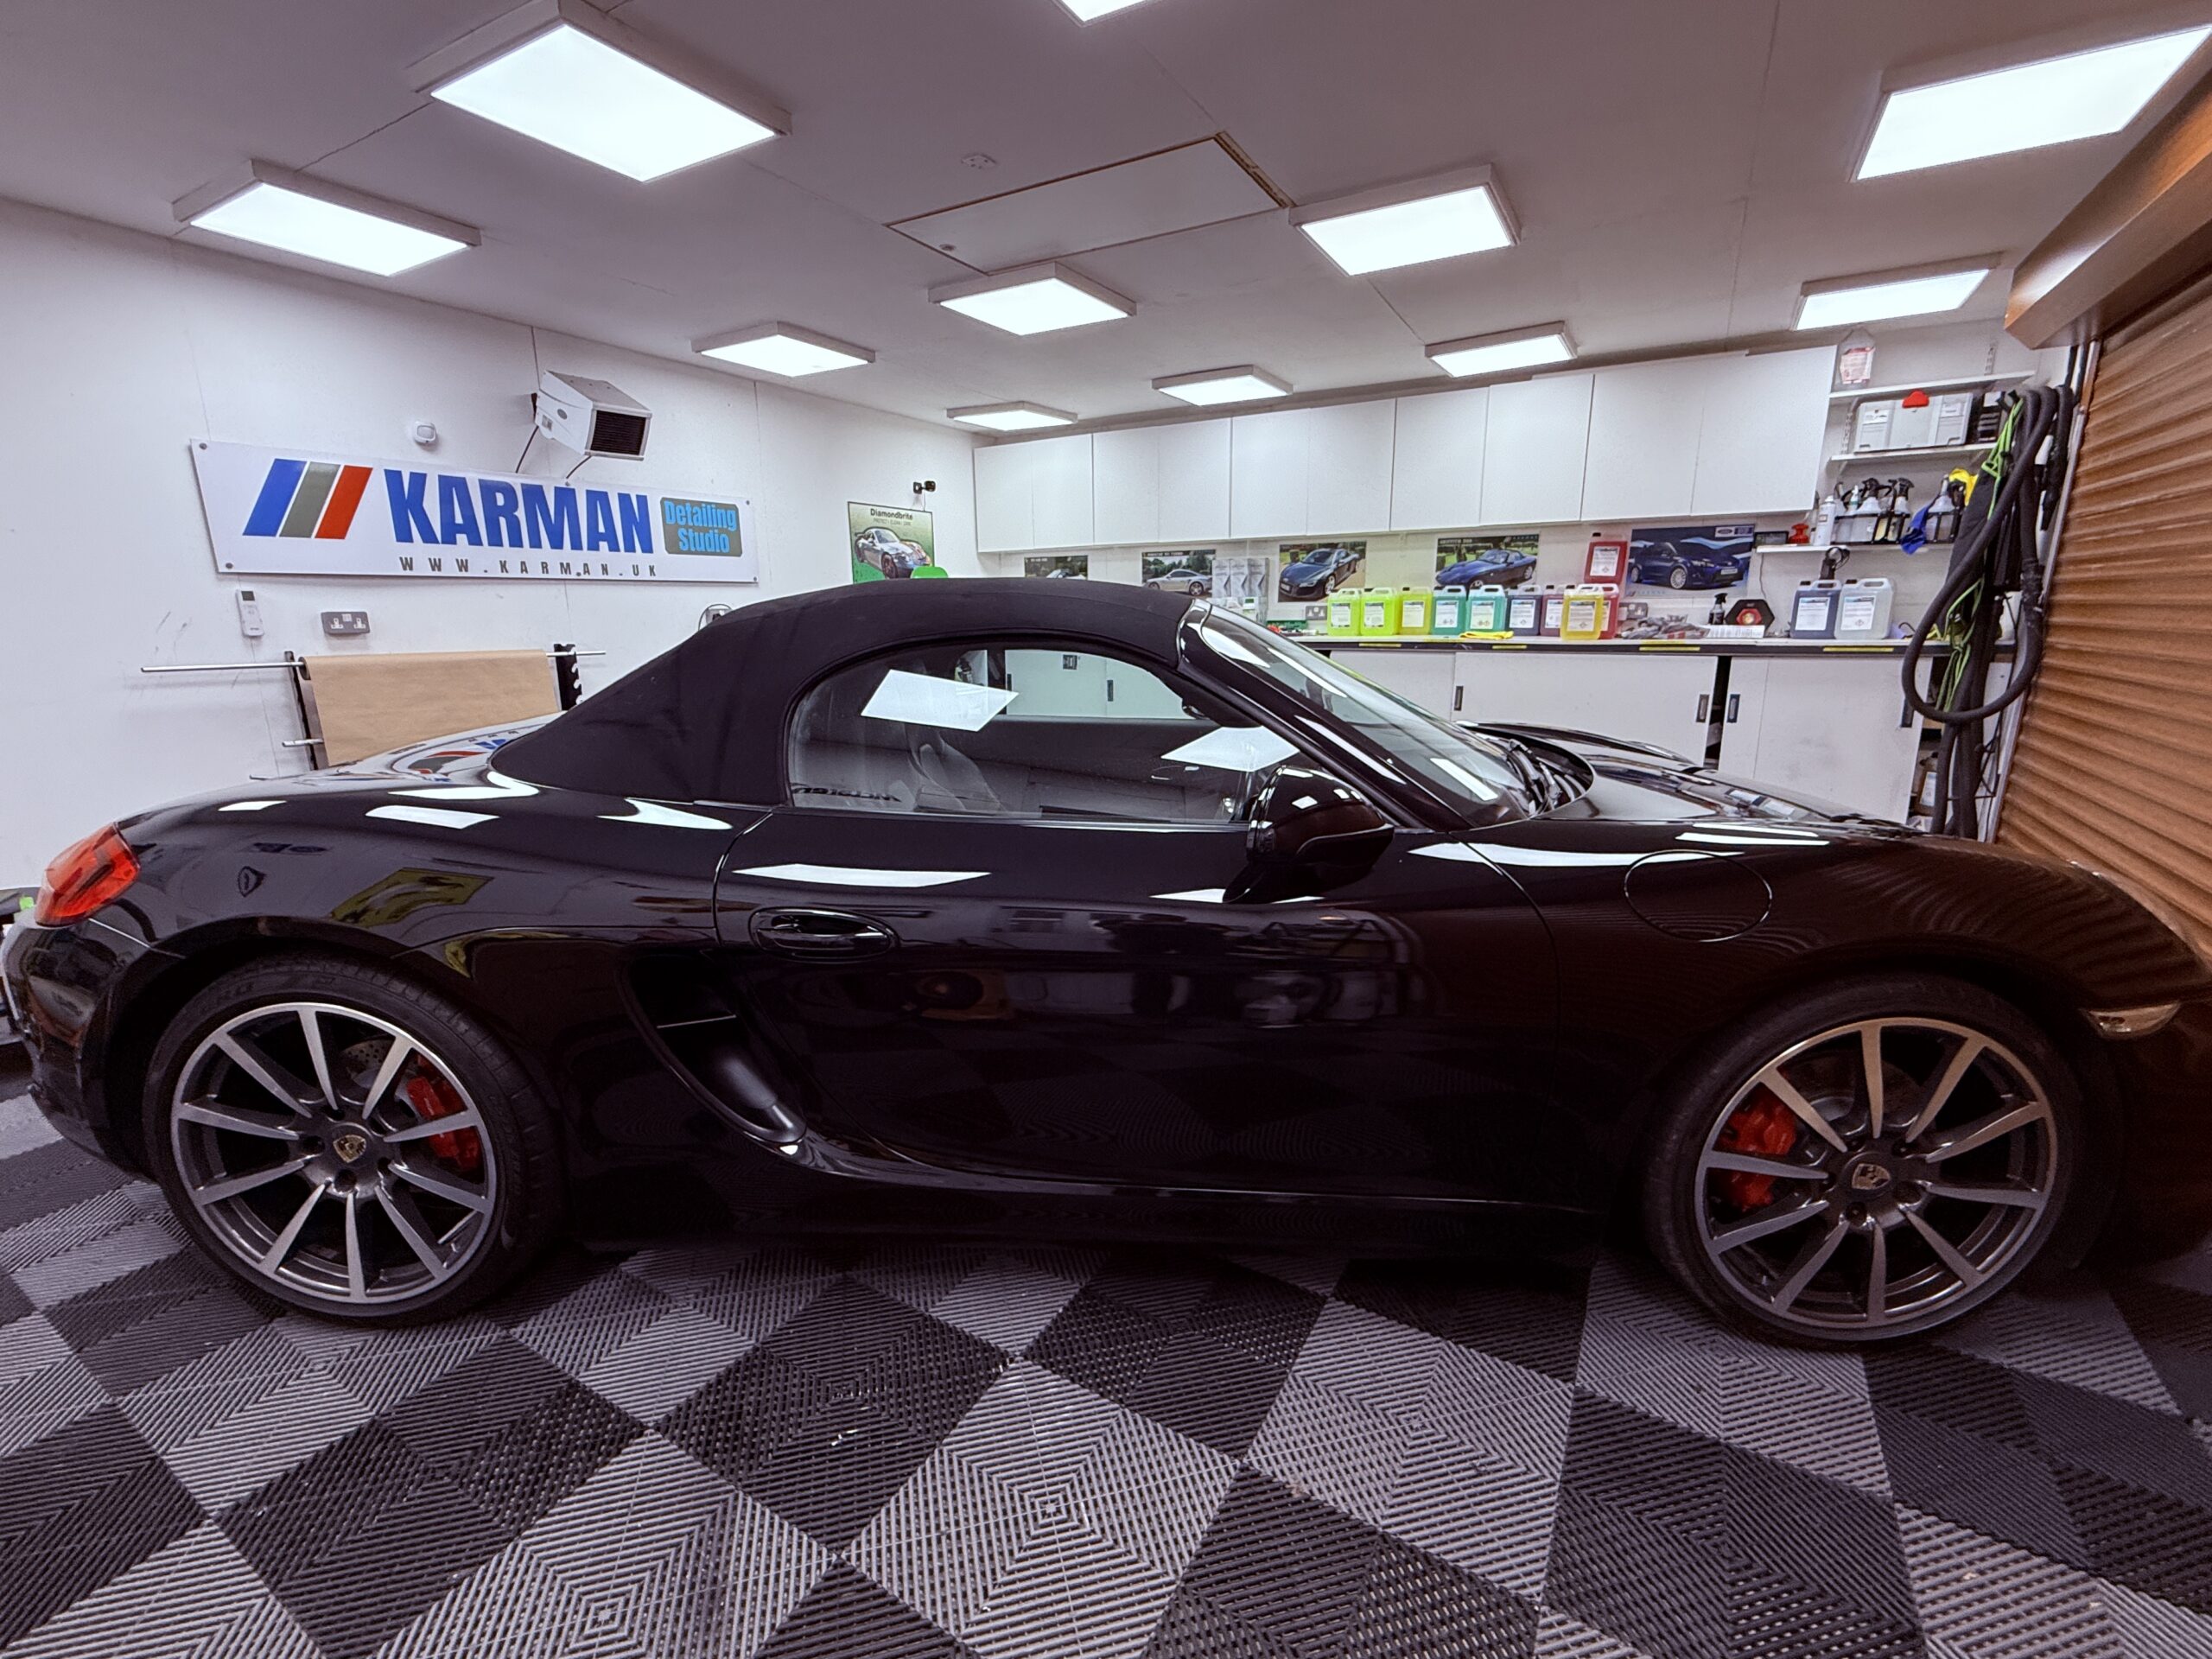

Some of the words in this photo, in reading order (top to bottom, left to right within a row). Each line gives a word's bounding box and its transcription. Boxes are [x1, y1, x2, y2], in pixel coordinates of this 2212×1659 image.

[383, 467, 654, 555] KARMAN
[663, 499, 738, 532] Detailing
[870, 508, 913, 521] Diamondbrite
[677, 527, 731, 554] Studio
